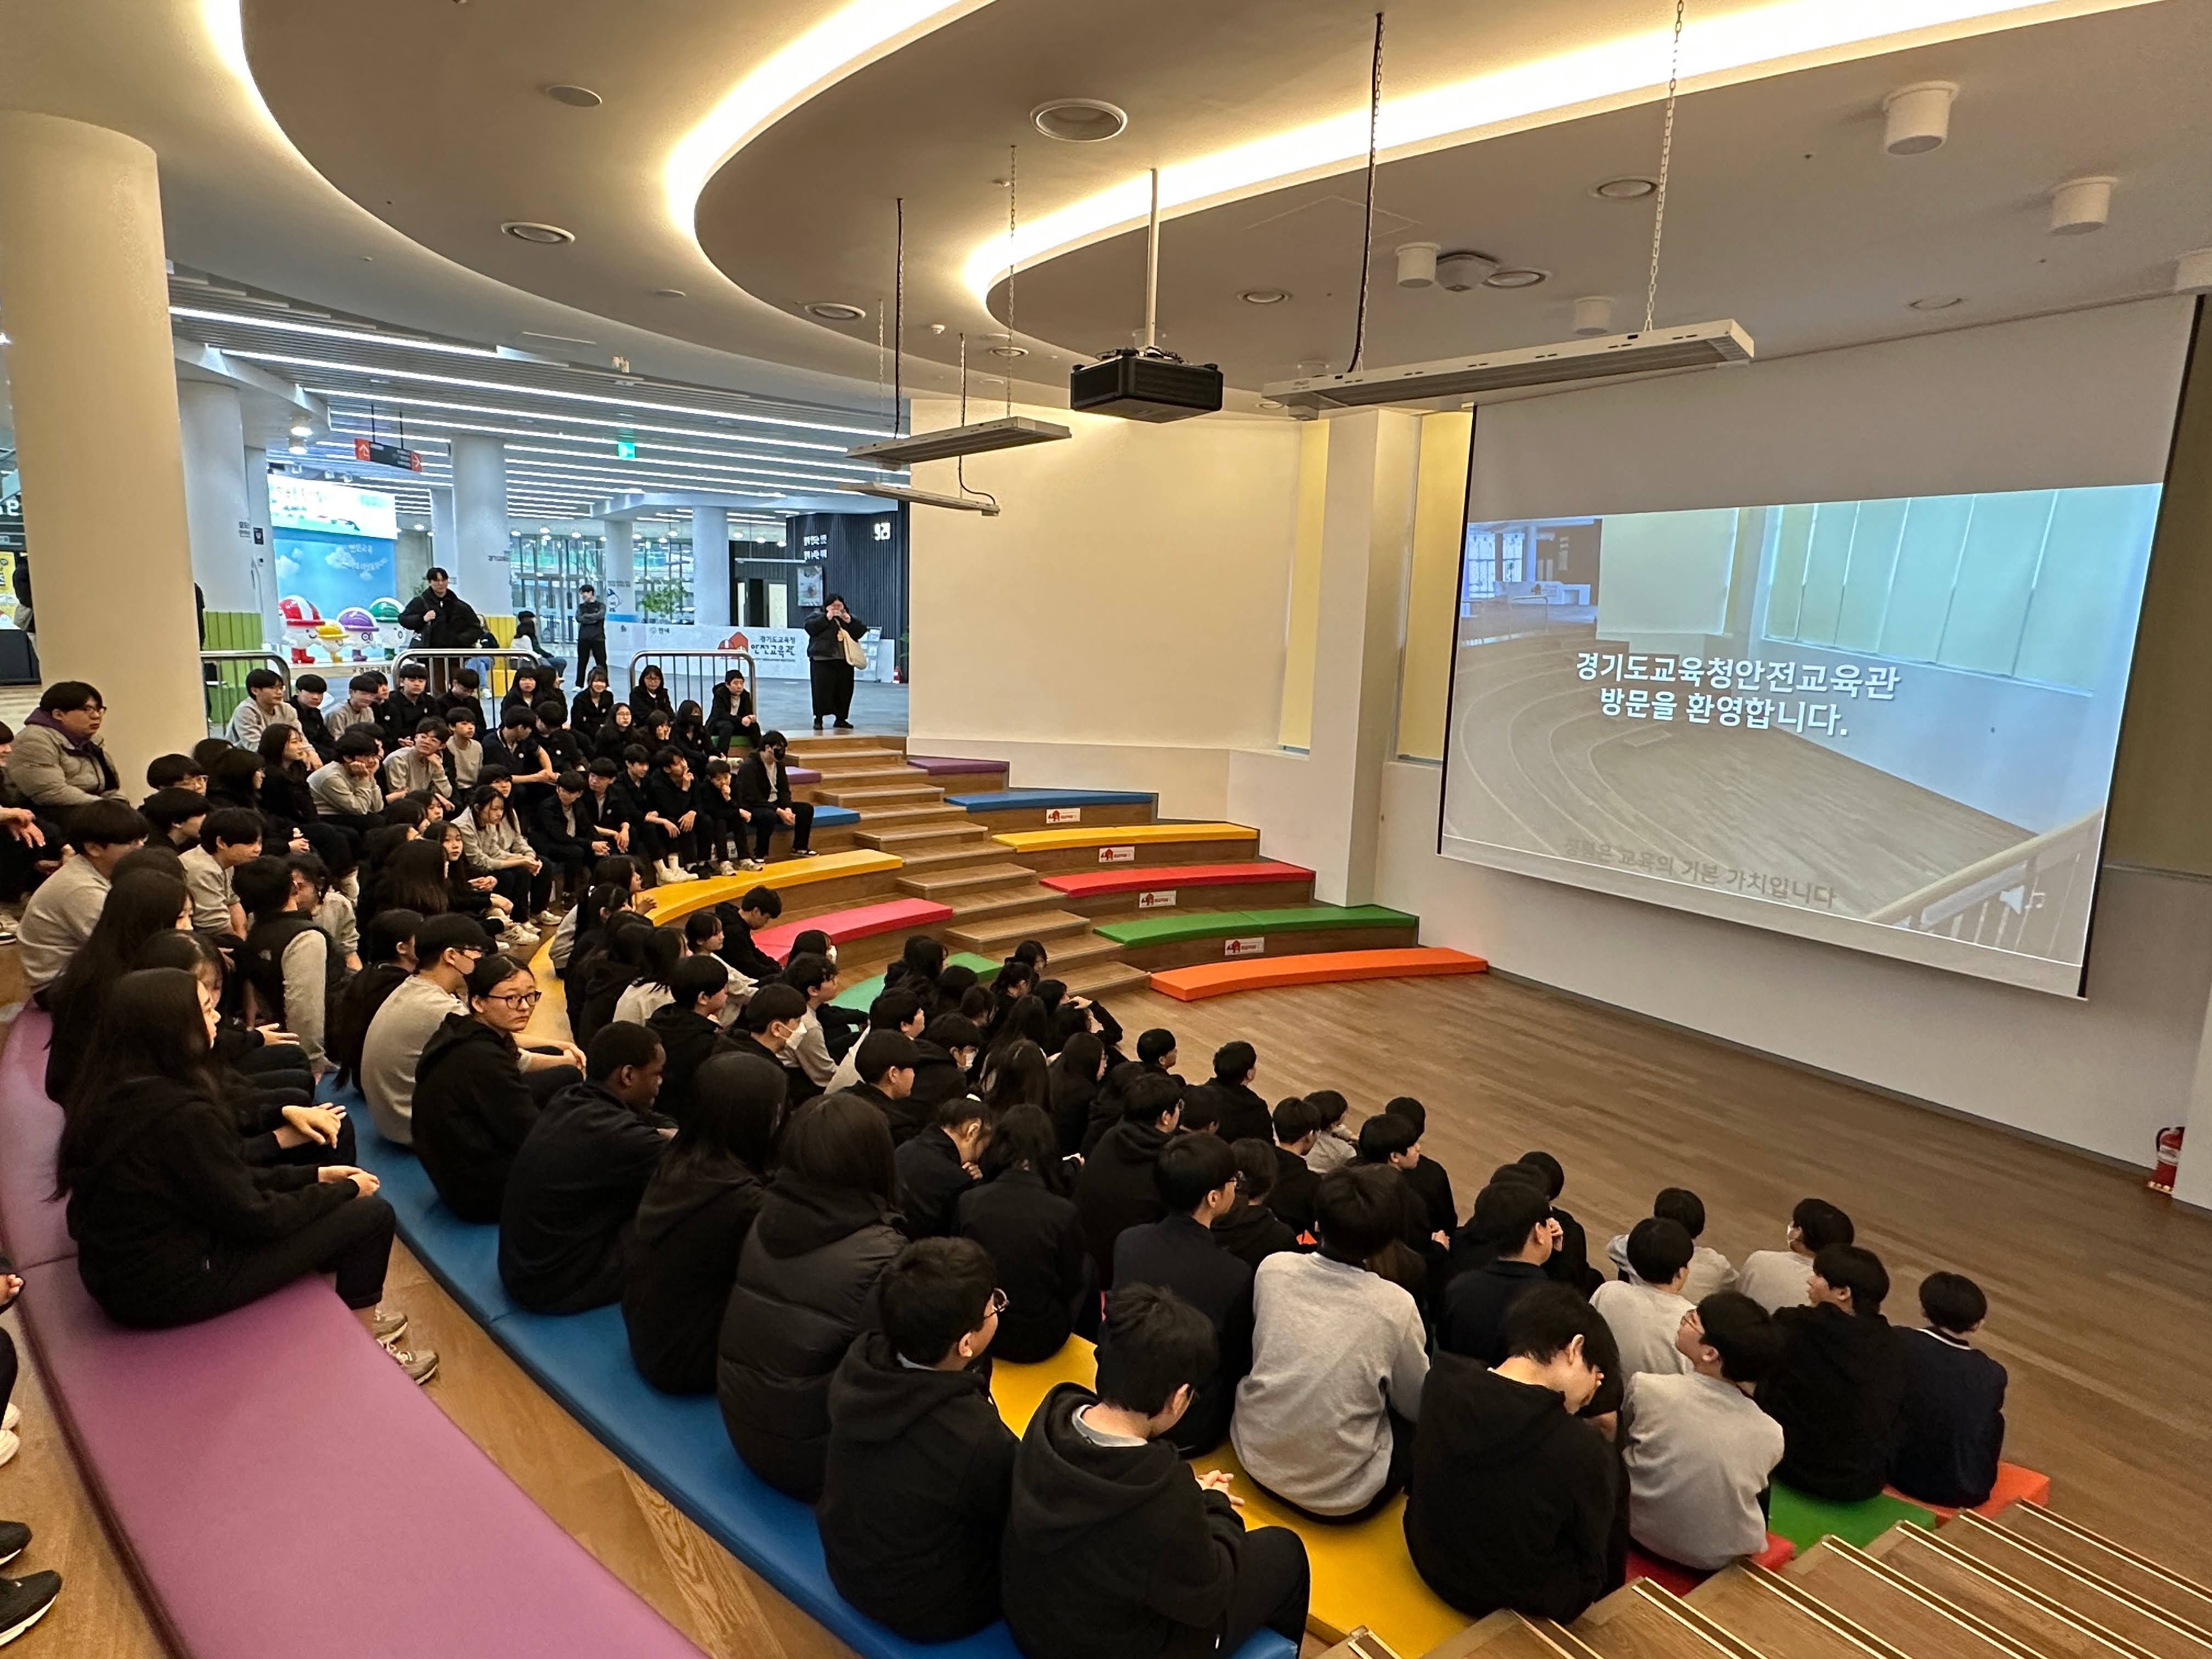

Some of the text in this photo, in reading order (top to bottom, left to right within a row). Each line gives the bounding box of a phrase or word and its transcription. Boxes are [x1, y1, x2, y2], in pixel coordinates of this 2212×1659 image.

[751, 644, 795, 658] 안전교육관
[760, 635, 795, 644] 경기도교육청
[1576, 652, 1901, 701] 경기도교육청안전교육관
[1600, 687, 1849, 737] 방문을 환영합니다.
[1617, 847, 1674, 876] 교육의
[1680, 860, 1719, 885] 기본
[1727, 869, 1838, 910] 가치입니다
